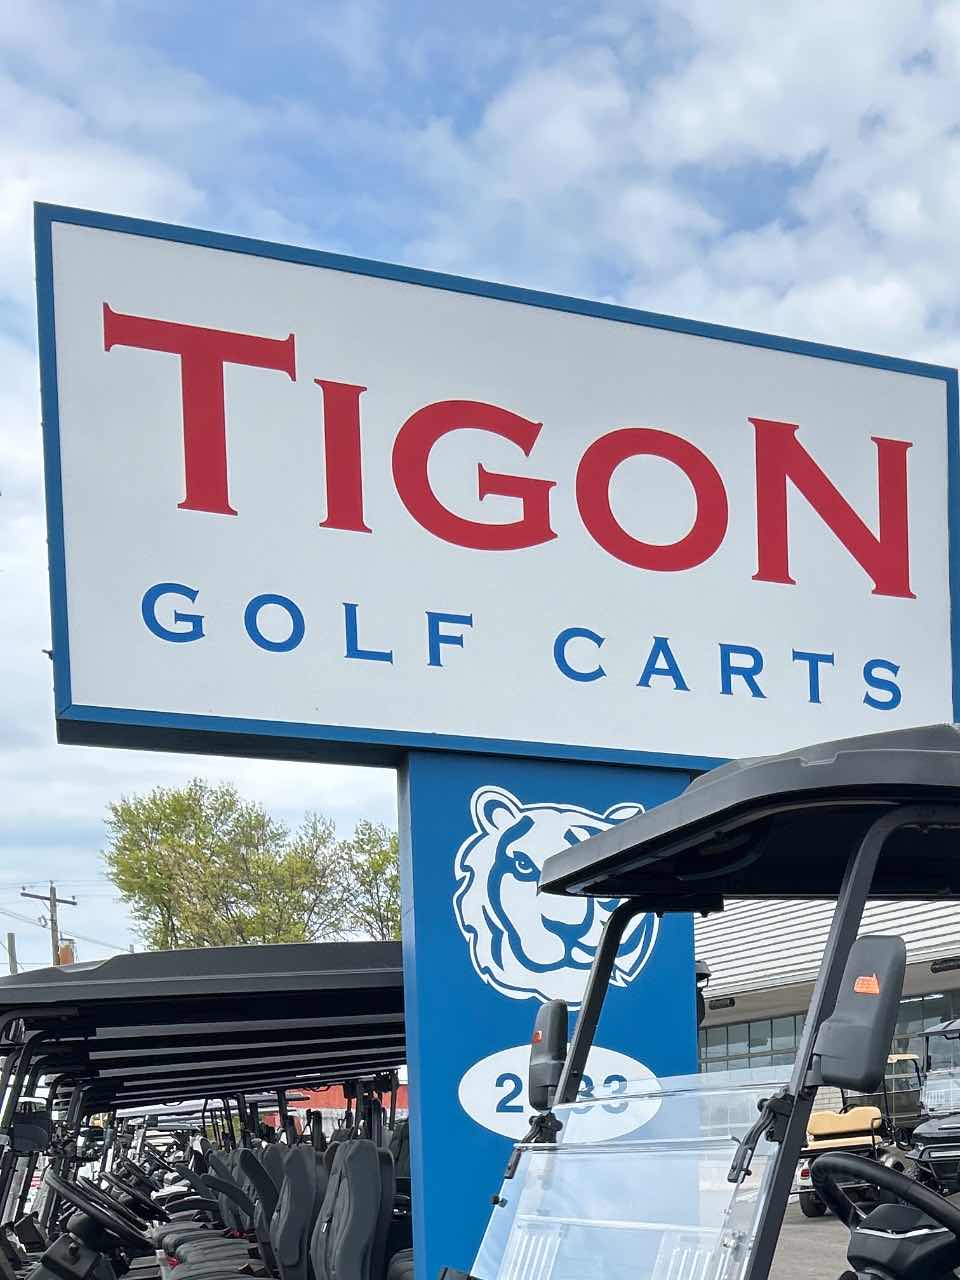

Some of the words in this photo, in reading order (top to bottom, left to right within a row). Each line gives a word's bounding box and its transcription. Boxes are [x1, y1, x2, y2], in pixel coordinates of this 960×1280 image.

[103, 302, 916, 599] TIGON
[140, 582, 474, 668] GOLF
[553, 626, 903, 711] CARTS
